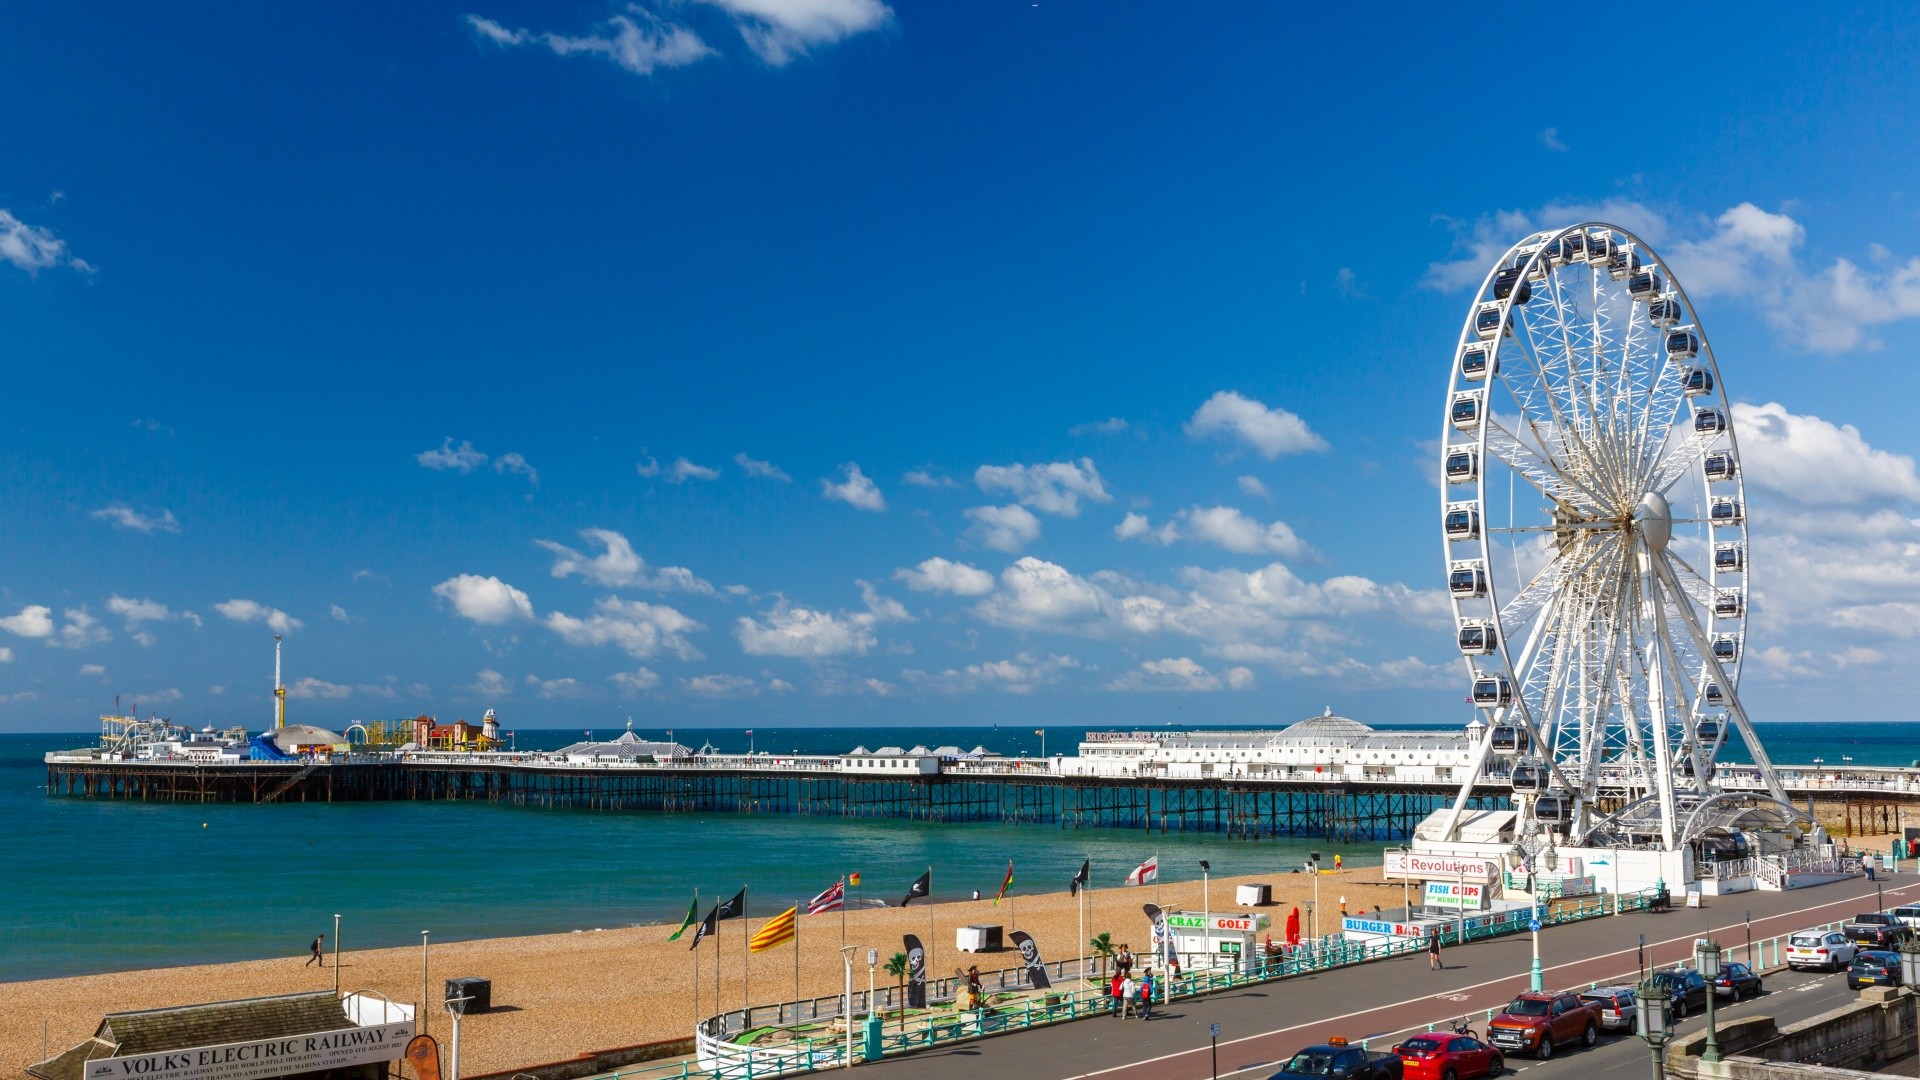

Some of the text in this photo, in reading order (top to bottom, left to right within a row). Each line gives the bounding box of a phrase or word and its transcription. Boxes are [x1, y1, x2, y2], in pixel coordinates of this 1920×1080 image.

[1086, 732, 1129, 741] BRIGHTON
[1400, 857, 1406, 869] 3
[1411, 858, 1484, 873] Revolutions
[1429, 884, 1450, 894] FISH
[1436, 896, 1459, 904] MUSHY
[1169, 916, 1210, 927] CRAZY
[1217, 919, 1251, 930] GOLF
[1483, 914, 1505, 925] COFEE
[1345, 919, 1391, 933] BURGER
[1395, 924, 1421, 936] BAR
[122, 1028, 387, 1075] VOLKS ELECTRIC RAILWAY
[147, 1072, 180, 1080] ELECTRIC
[183, 1068, 213, 1076] RAILWAY
[240, 1060, 265, 1068] WORLD
[266, 1057, 284, 1065] STILL
[285, 1053, 322, 1062] OPERATING
[295, 1061, 321, 1069] MARINA
